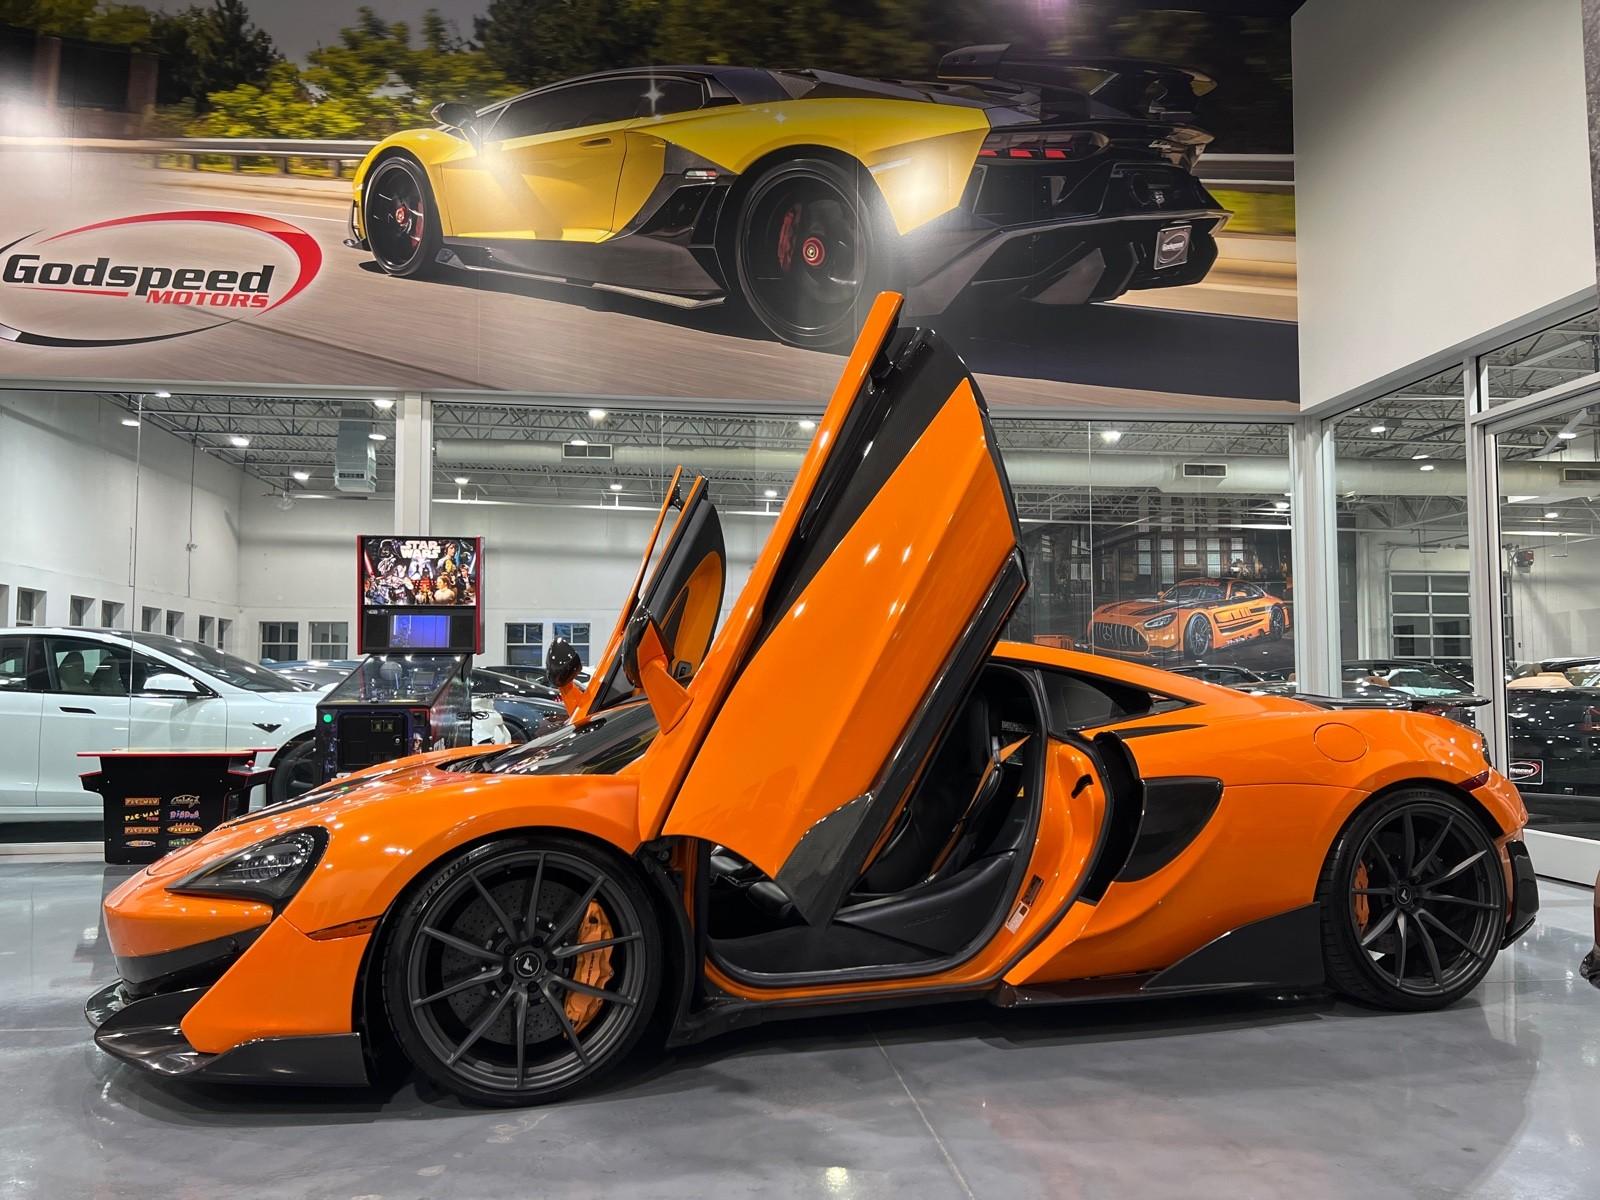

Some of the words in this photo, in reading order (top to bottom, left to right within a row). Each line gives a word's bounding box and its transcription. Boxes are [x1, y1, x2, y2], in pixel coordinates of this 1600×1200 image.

[2, 254, 275, 296] Godspeed
[146, 289, 270, 308] MOTORS
[400, 540, 440, 550] STAR
[400, 548, 441, 559] WARS
[125, 809, 160, 821] PAC-MAN
